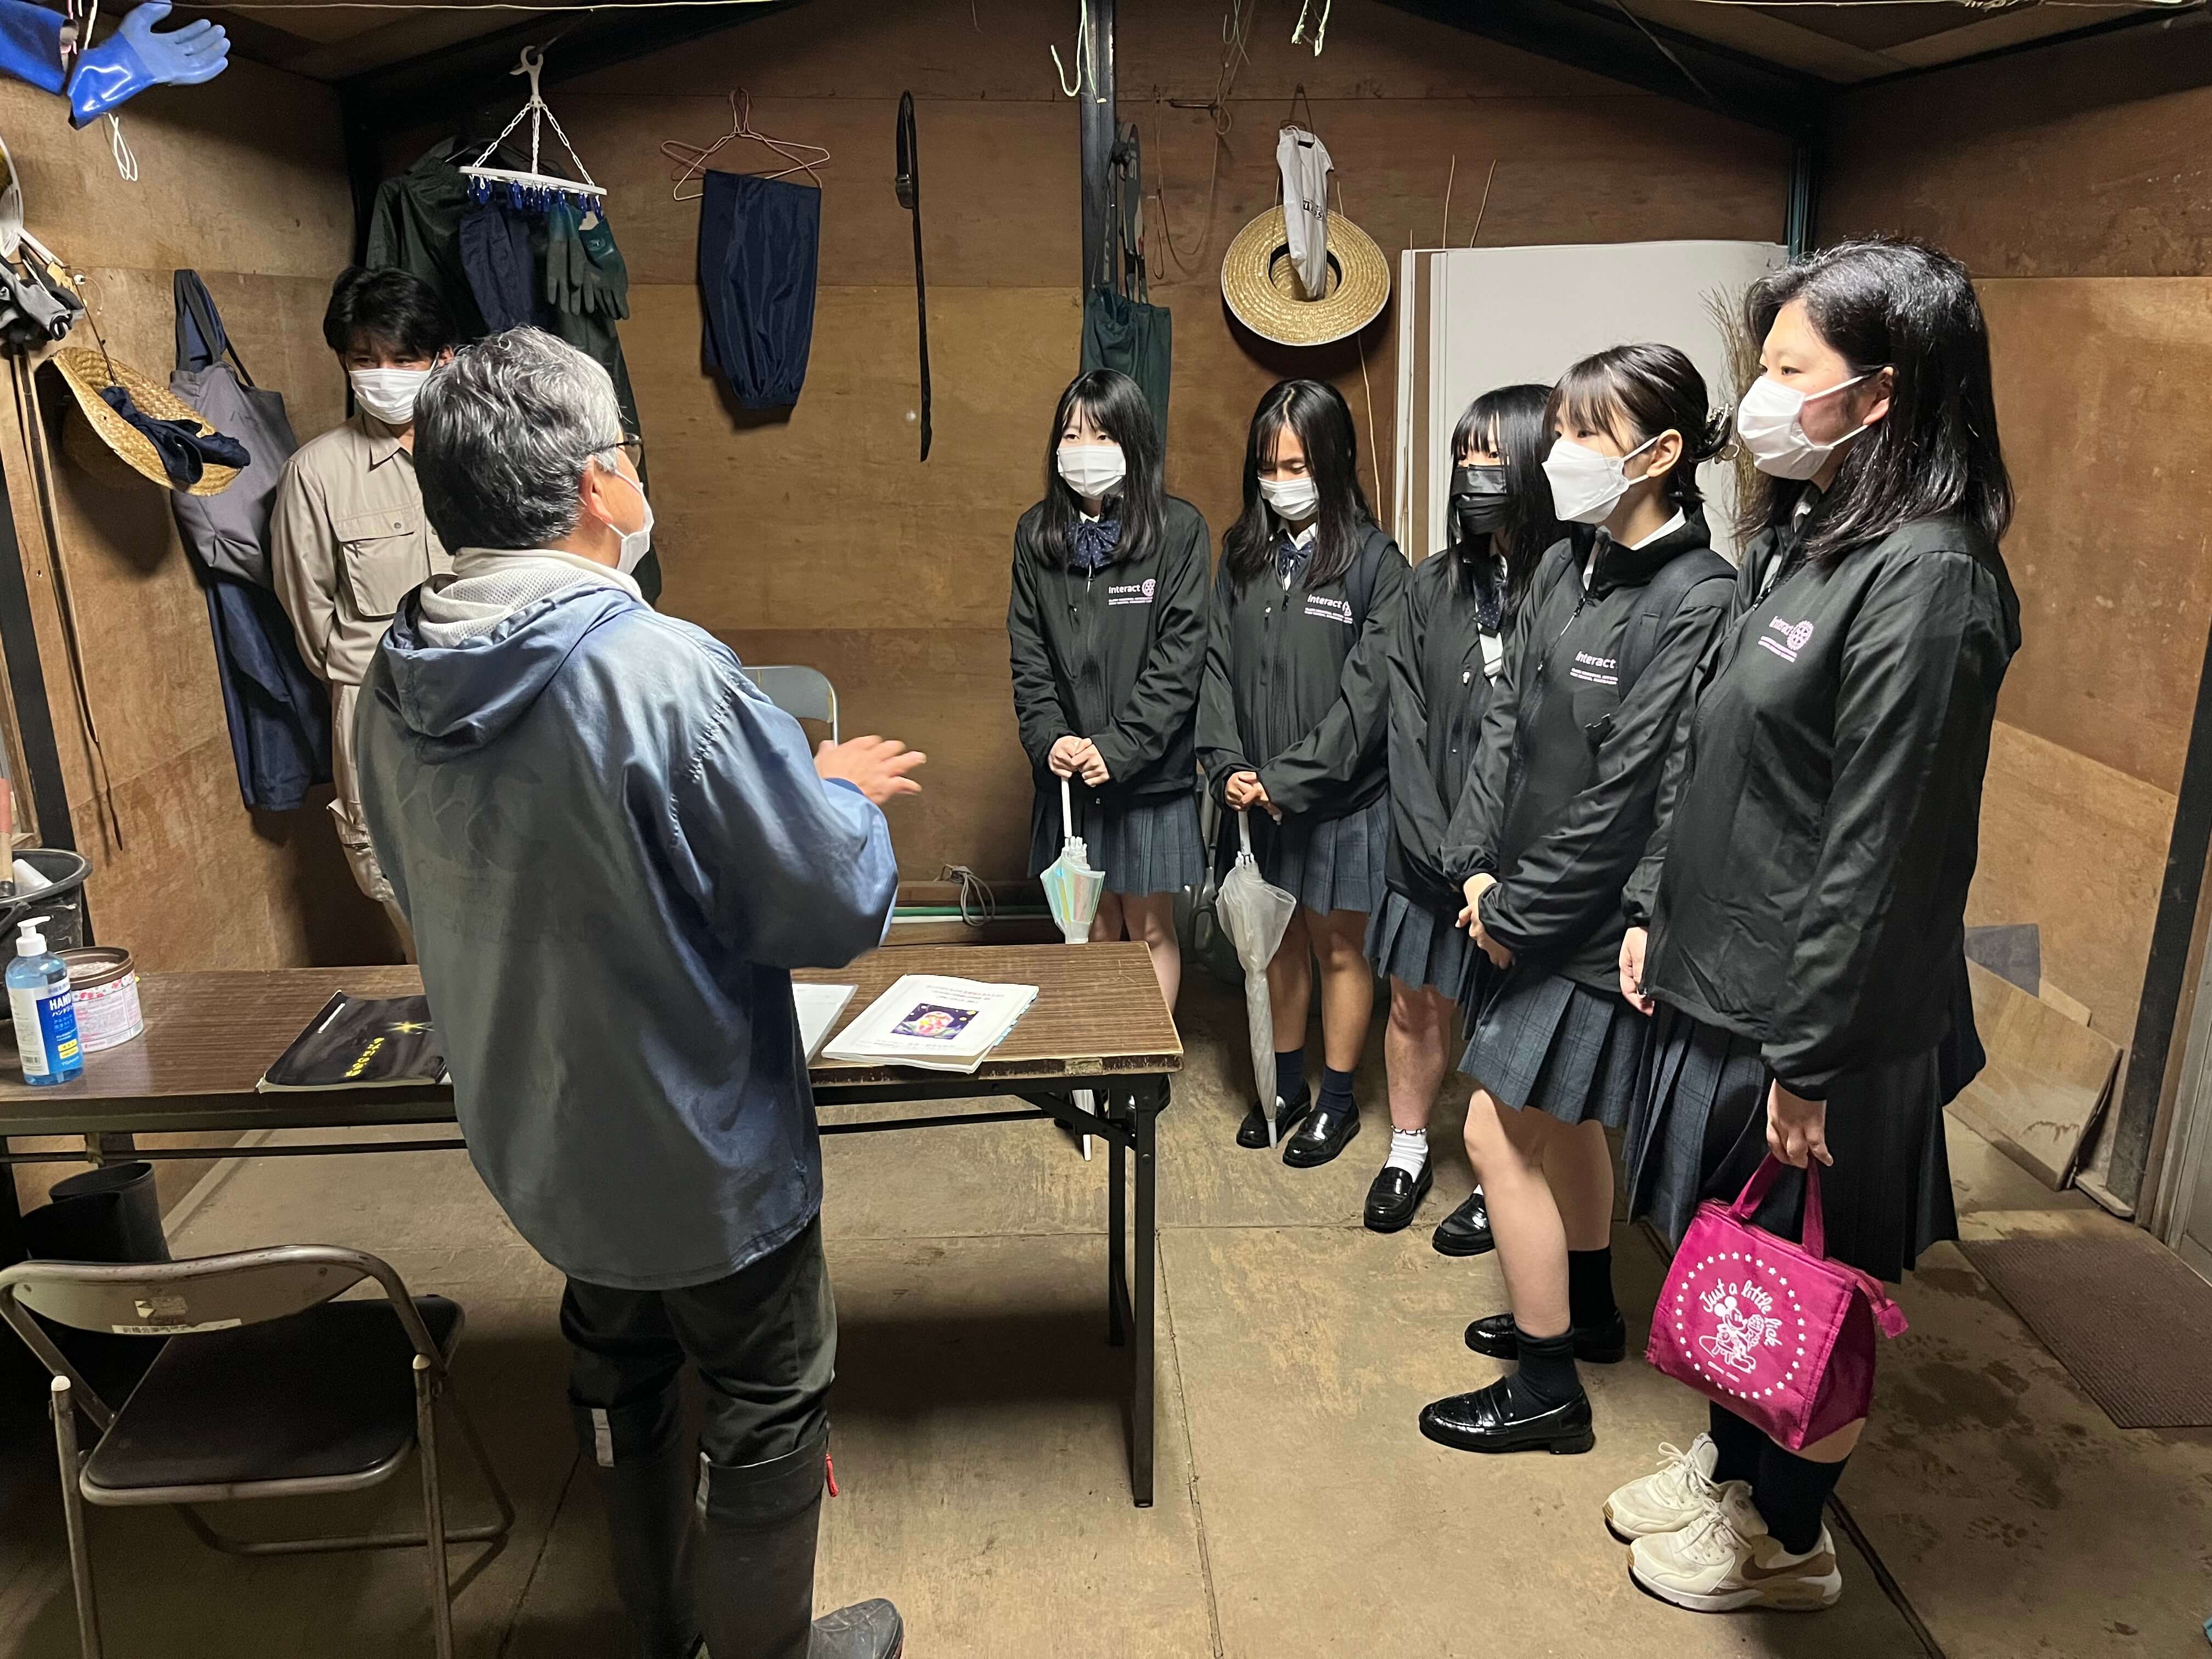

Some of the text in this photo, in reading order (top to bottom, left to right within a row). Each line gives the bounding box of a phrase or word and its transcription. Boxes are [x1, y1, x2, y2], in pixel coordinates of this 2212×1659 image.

[1108, 584, 1141, 594] Interact
[1307, 594, 1343, 608] Interact
[1575, 651, 1616, 669] Interact
[49, 992, 71, 1011] HAND
[1699, 1278, 1782, 1346] Just a little lick
